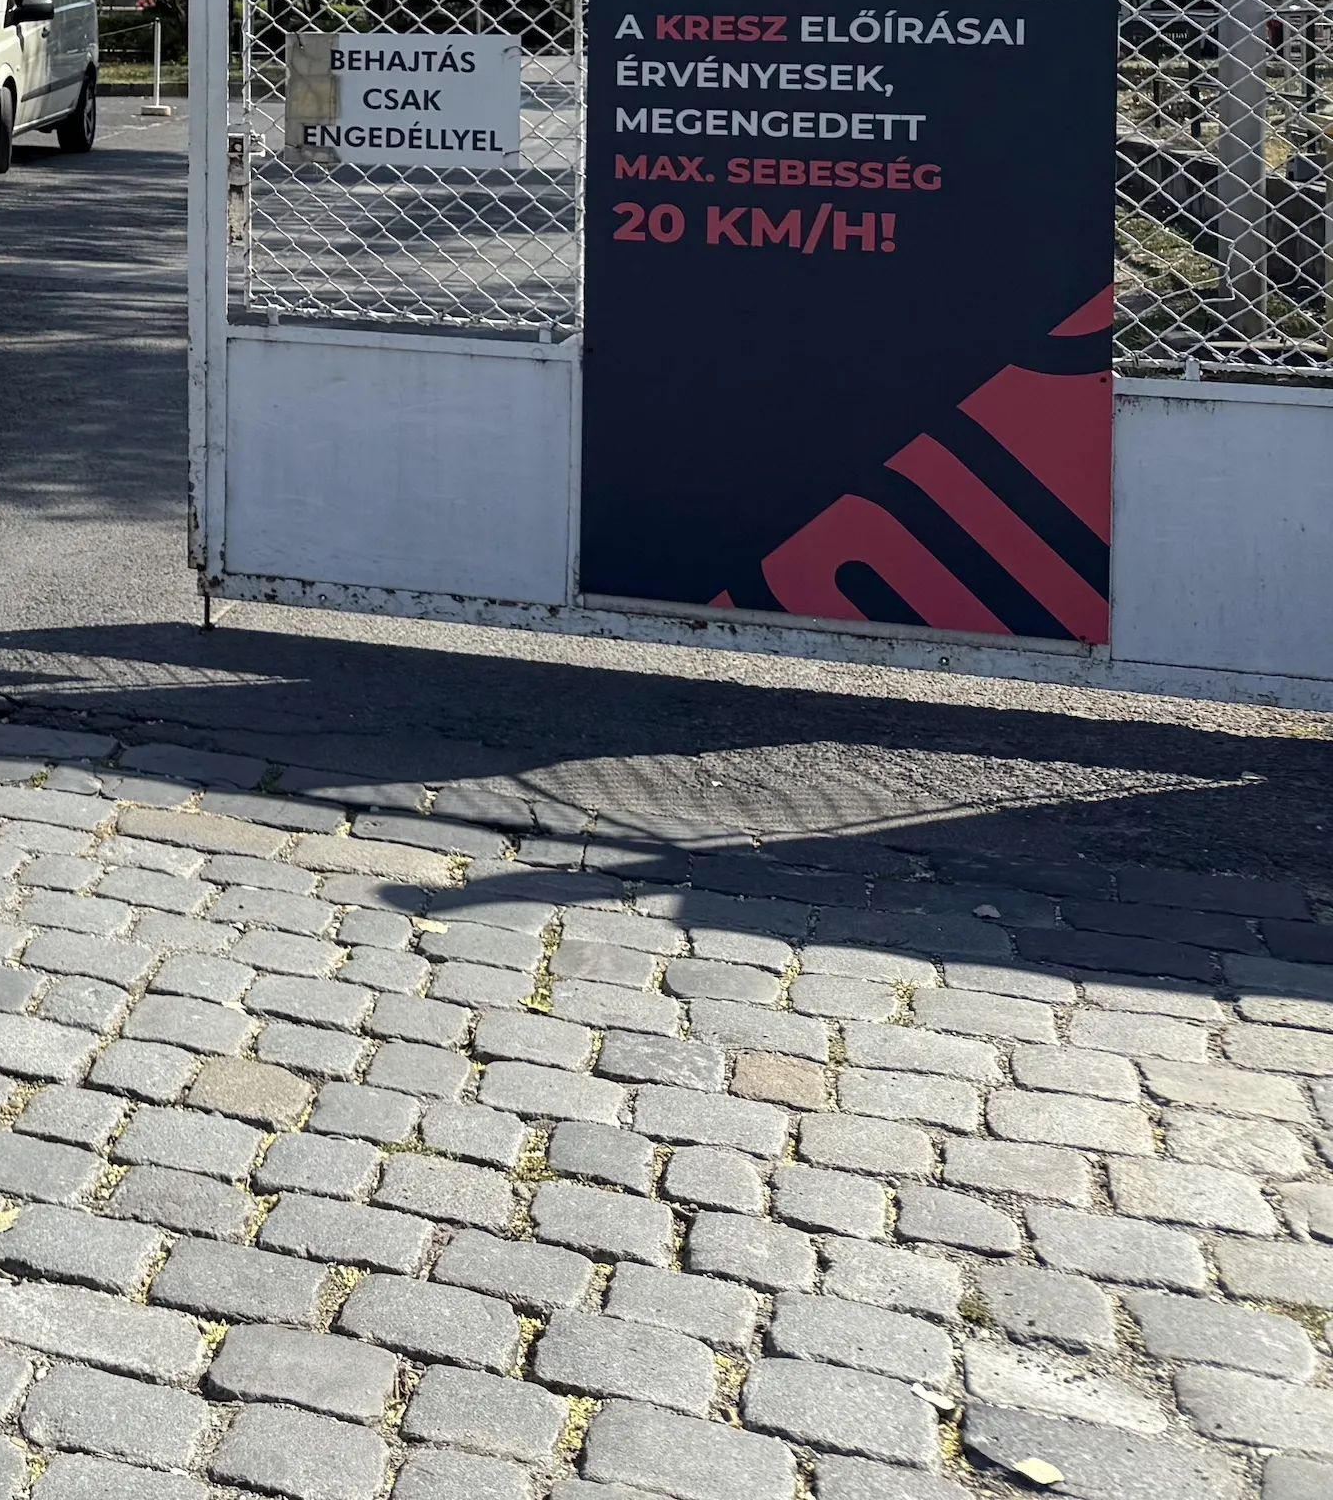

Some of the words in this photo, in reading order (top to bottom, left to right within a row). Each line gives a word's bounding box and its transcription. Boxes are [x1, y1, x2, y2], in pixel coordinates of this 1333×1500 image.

[614, 13, 645, 40] A
[655, 13, 788, 43] KRESZ
[800, 9, 1026, 45] ELŐÍRÁSAI
[330, 44, 476, 73] BEHAJTÁS
[615, 53, 895, 98] ÉRVÉNYESEK,
[362, 88, 442, 111] CSAK
[303, 121, 503, 152] ENGEDÉLLYEL
[615, 107, 928, 142] MEGENGEDETT
[614, 153, 716, 182] MAX.
[726, 155, 943, 190] SEBESSÉG
[612, 202, 686, 243] 20
[706, 202, 897, 255] KM/H!
